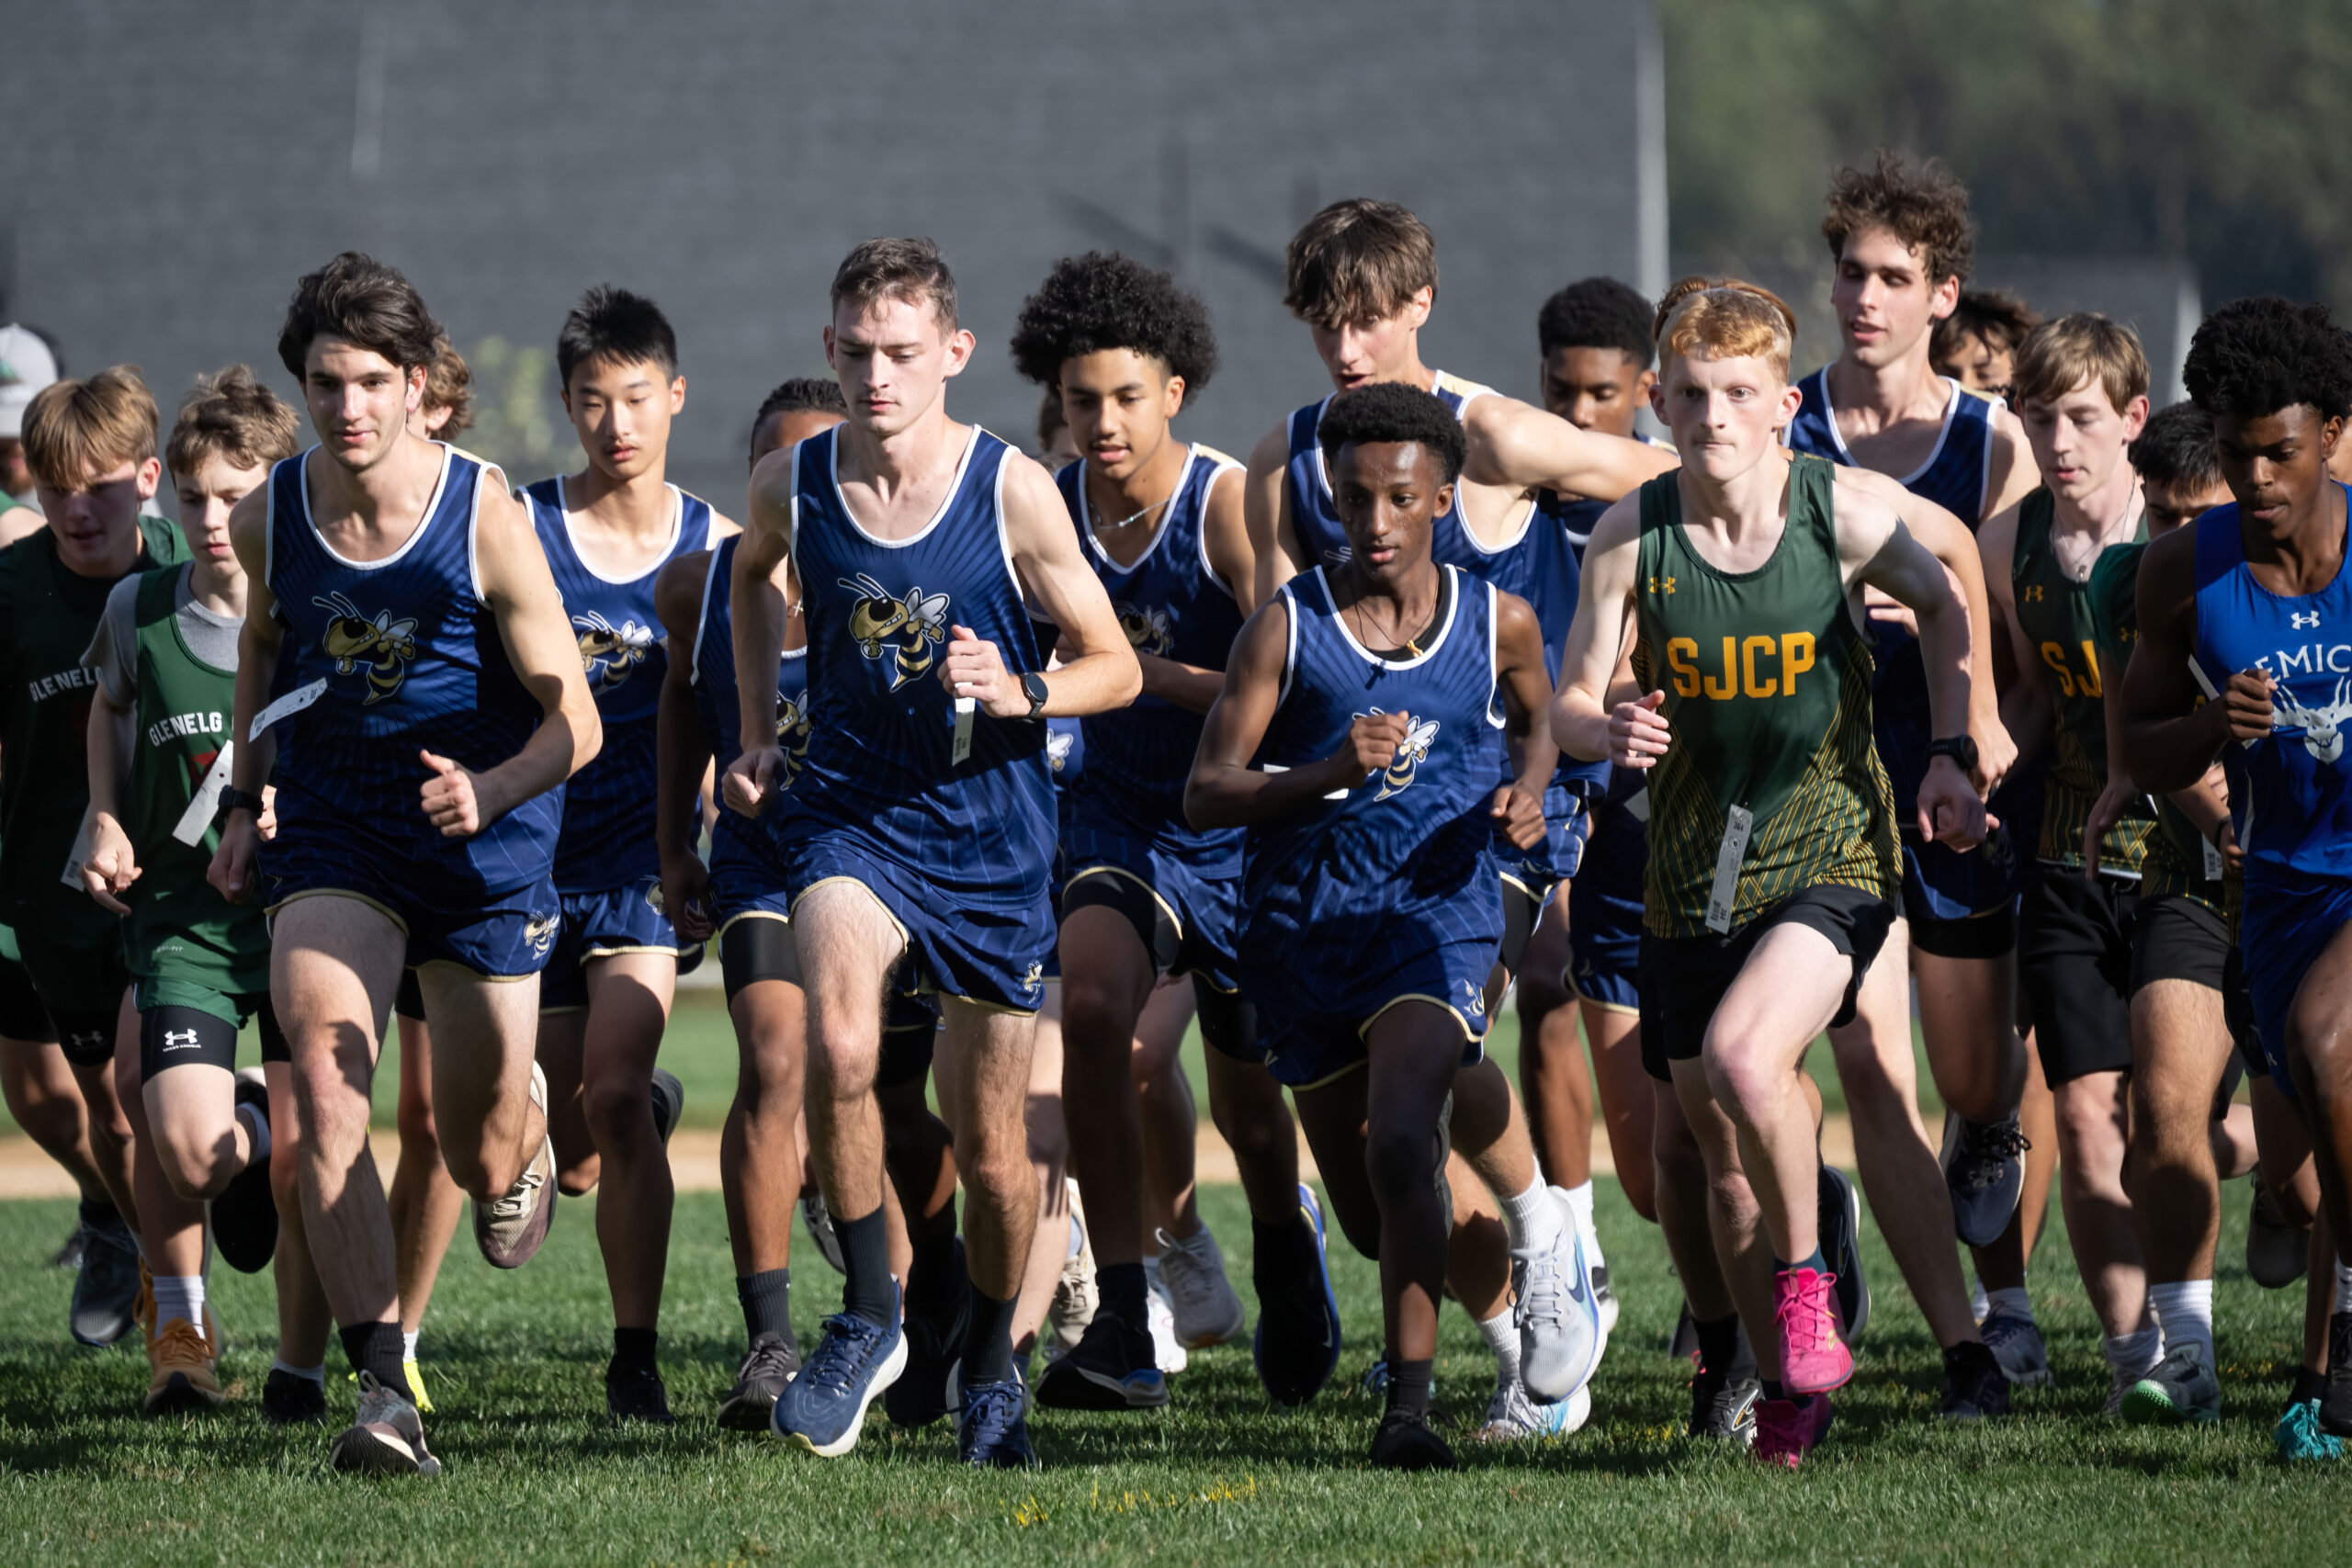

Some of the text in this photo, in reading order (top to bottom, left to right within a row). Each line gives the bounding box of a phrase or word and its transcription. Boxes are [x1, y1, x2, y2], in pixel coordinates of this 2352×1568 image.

[1667, 630, 1816, 701] SJCP
[2240, 644, 2352, 685] EMIC
[148, 711, 223, 748] GLENELG
